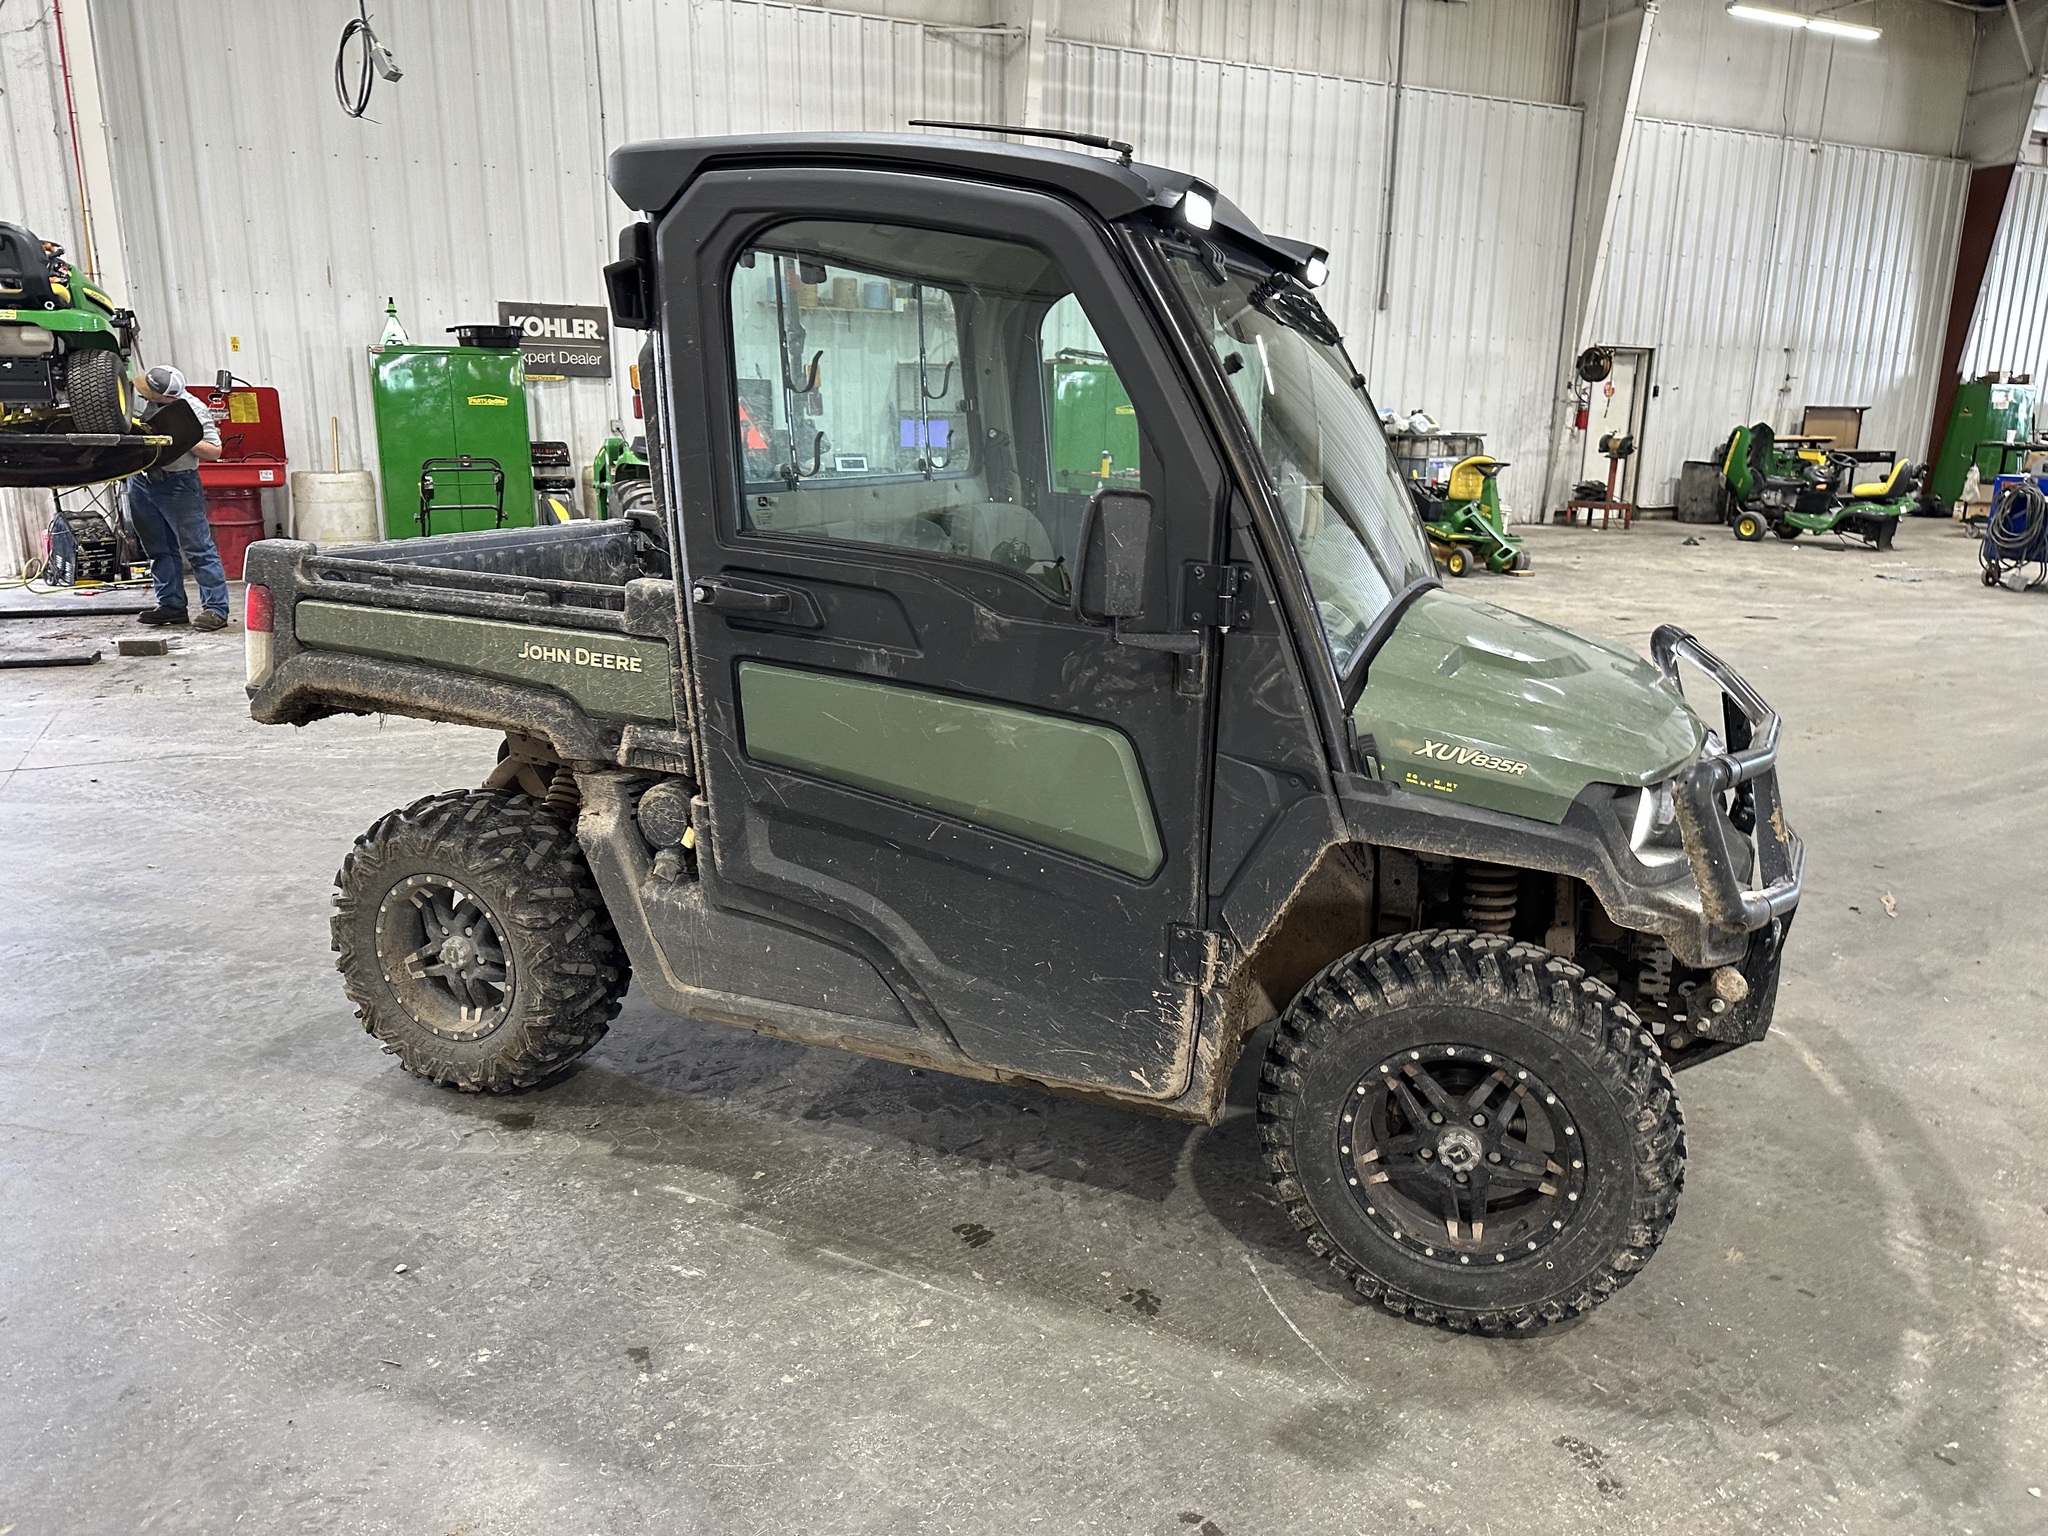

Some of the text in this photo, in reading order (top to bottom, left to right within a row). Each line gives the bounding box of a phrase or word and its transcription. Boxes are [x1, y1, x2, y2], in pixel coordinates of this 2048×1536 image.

[523, 351, 602, 365] xpert Dealer
[518, 641, 642, 672] JOHN DEERE
[1414, 739, 1529, 776] XUV835R
